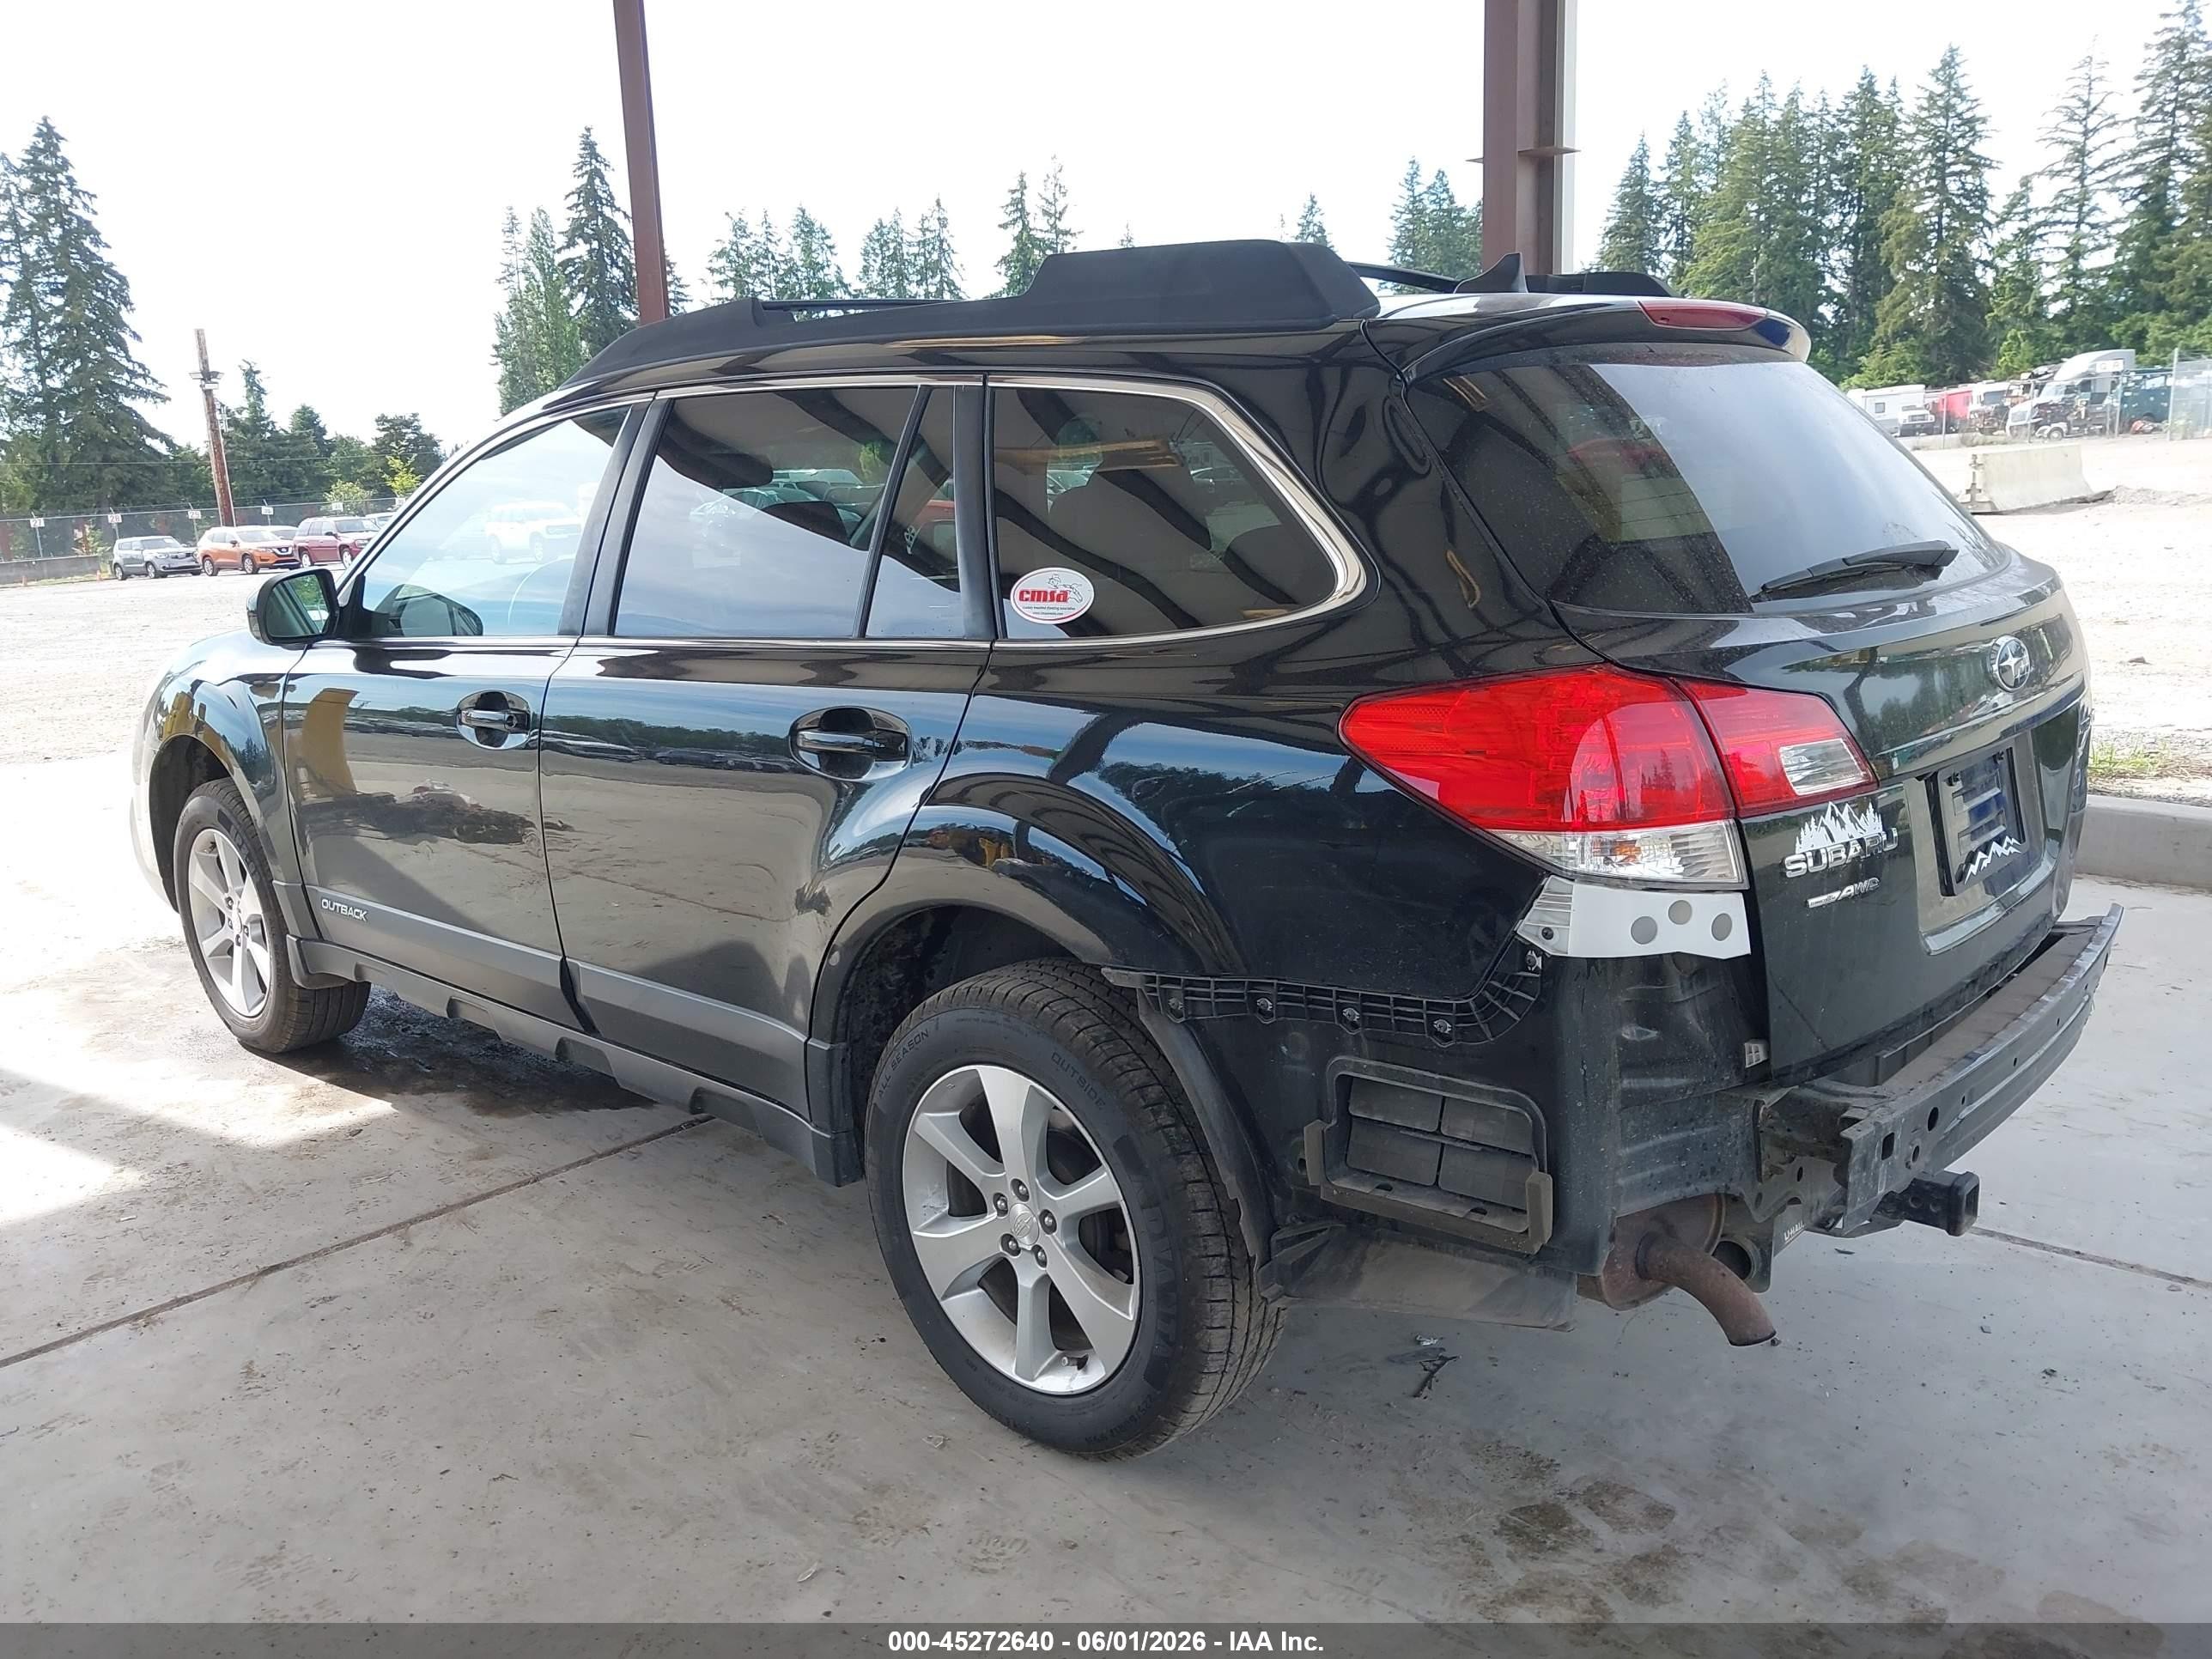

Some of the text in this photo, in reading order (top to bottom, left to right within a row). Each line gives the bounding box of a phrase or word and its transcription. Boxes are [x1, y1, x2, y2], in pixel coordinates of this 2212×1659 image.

[1018, 588, 1070, 604] cmsa
[1784, 826, 1899, 879] SUBARU
[1838, 877, 1881, 901] AWD
[321, 898, 368, 922] OUTBACK
[878, 1028, 930, 1097] ALL SEASON
[1050, 1051, 1107, 1110] OUTSIDE
